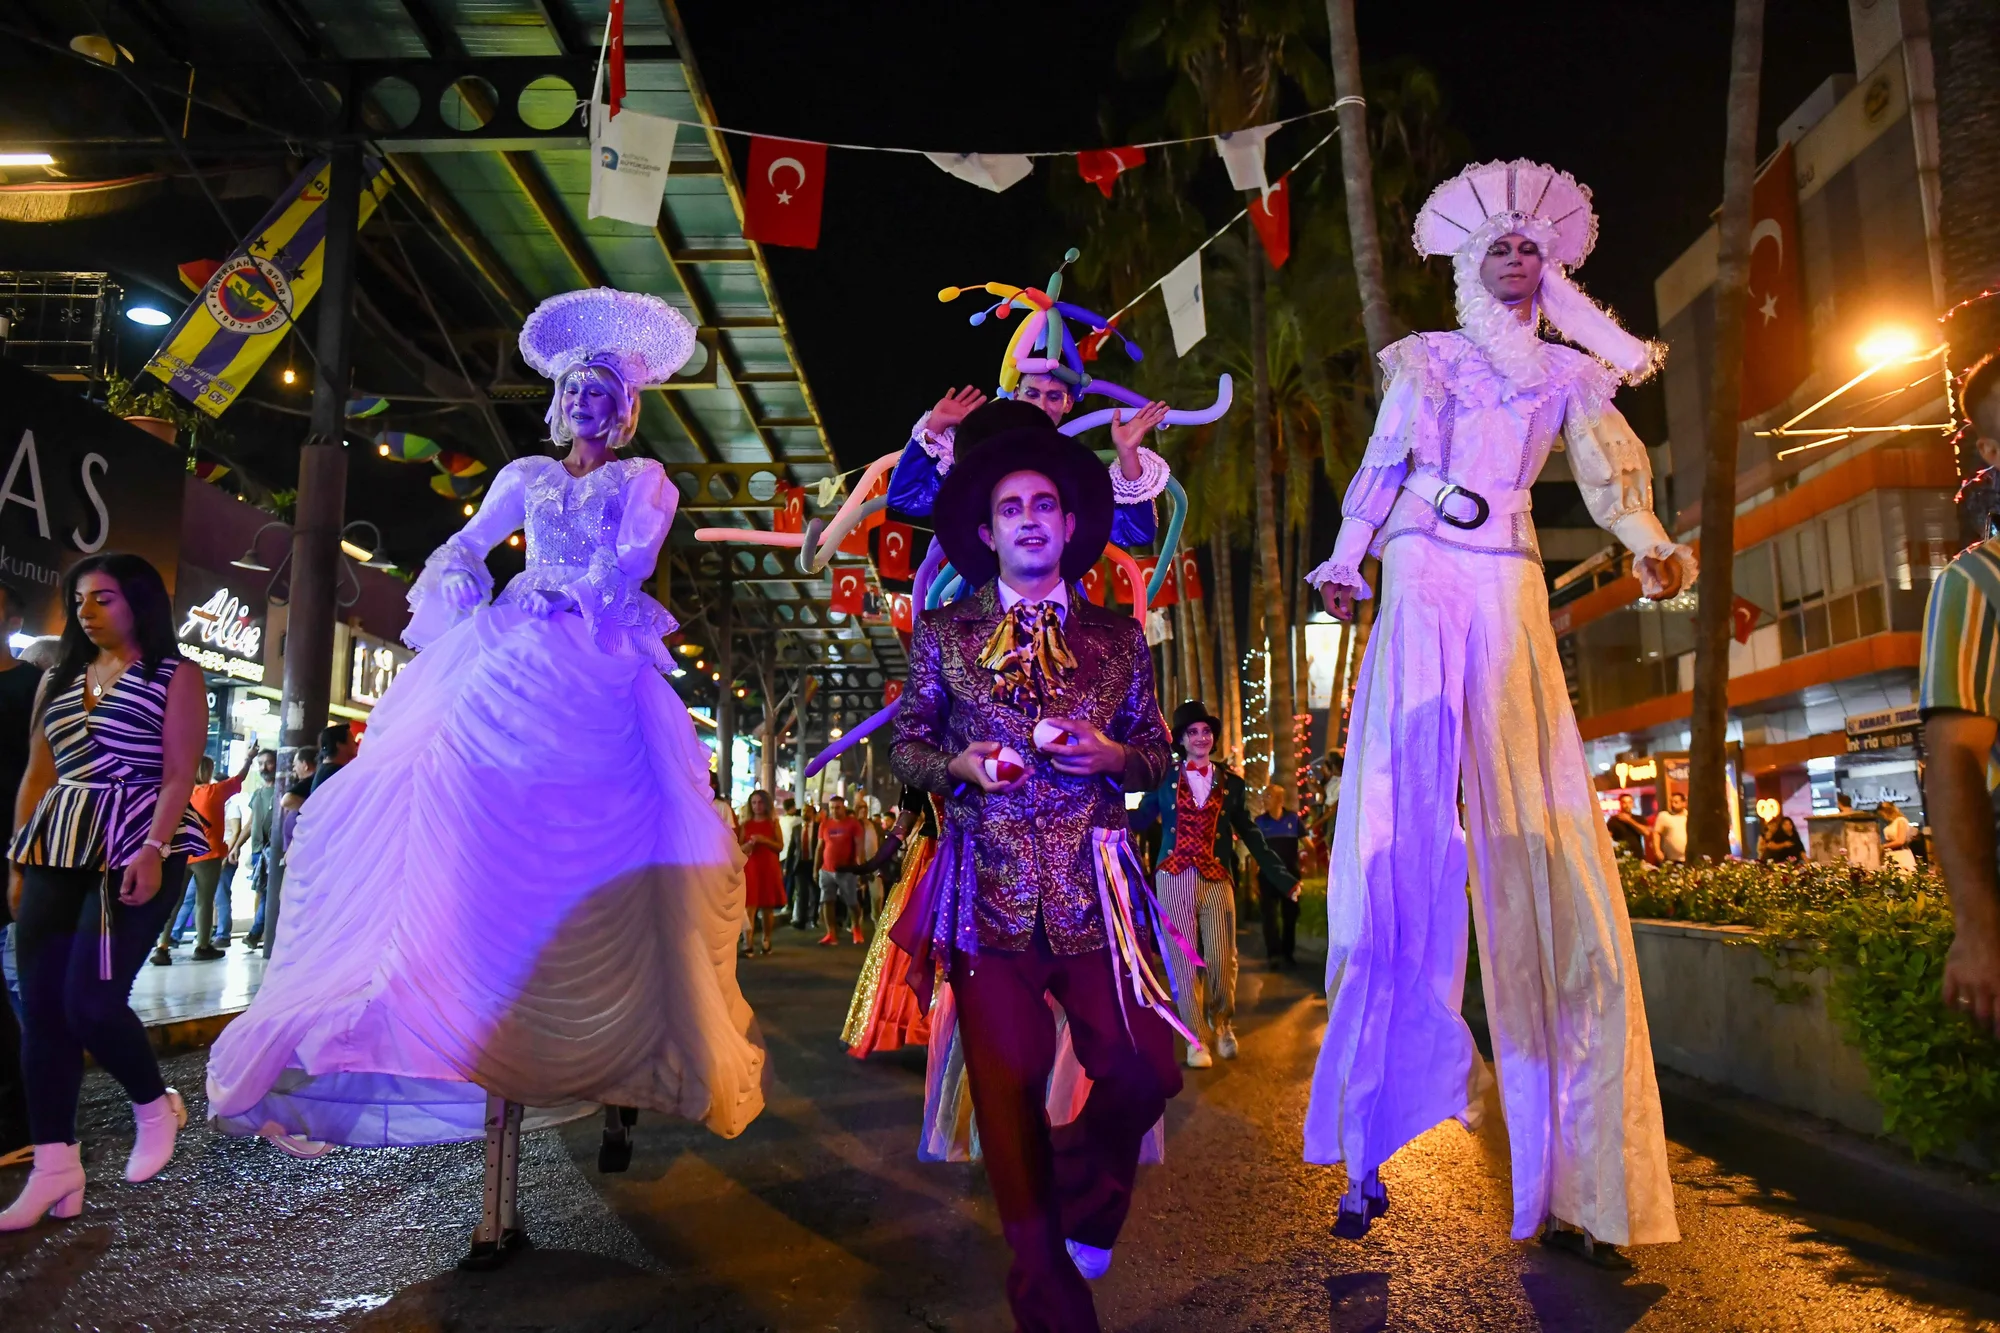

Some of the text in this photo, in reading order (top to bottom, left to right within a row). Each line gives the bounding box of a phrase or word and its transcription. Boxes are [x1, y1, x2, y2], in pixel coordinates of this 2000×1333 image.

[210, 259, 264, 298] FENERBAHE
[266, 268, 286, 295] SPOR
[217, 310, 244, 329] 1907
[192, 379, 209, 394] 76
[209, 390, 227, 405] 57
[179, 588, 261, 657] Alin
